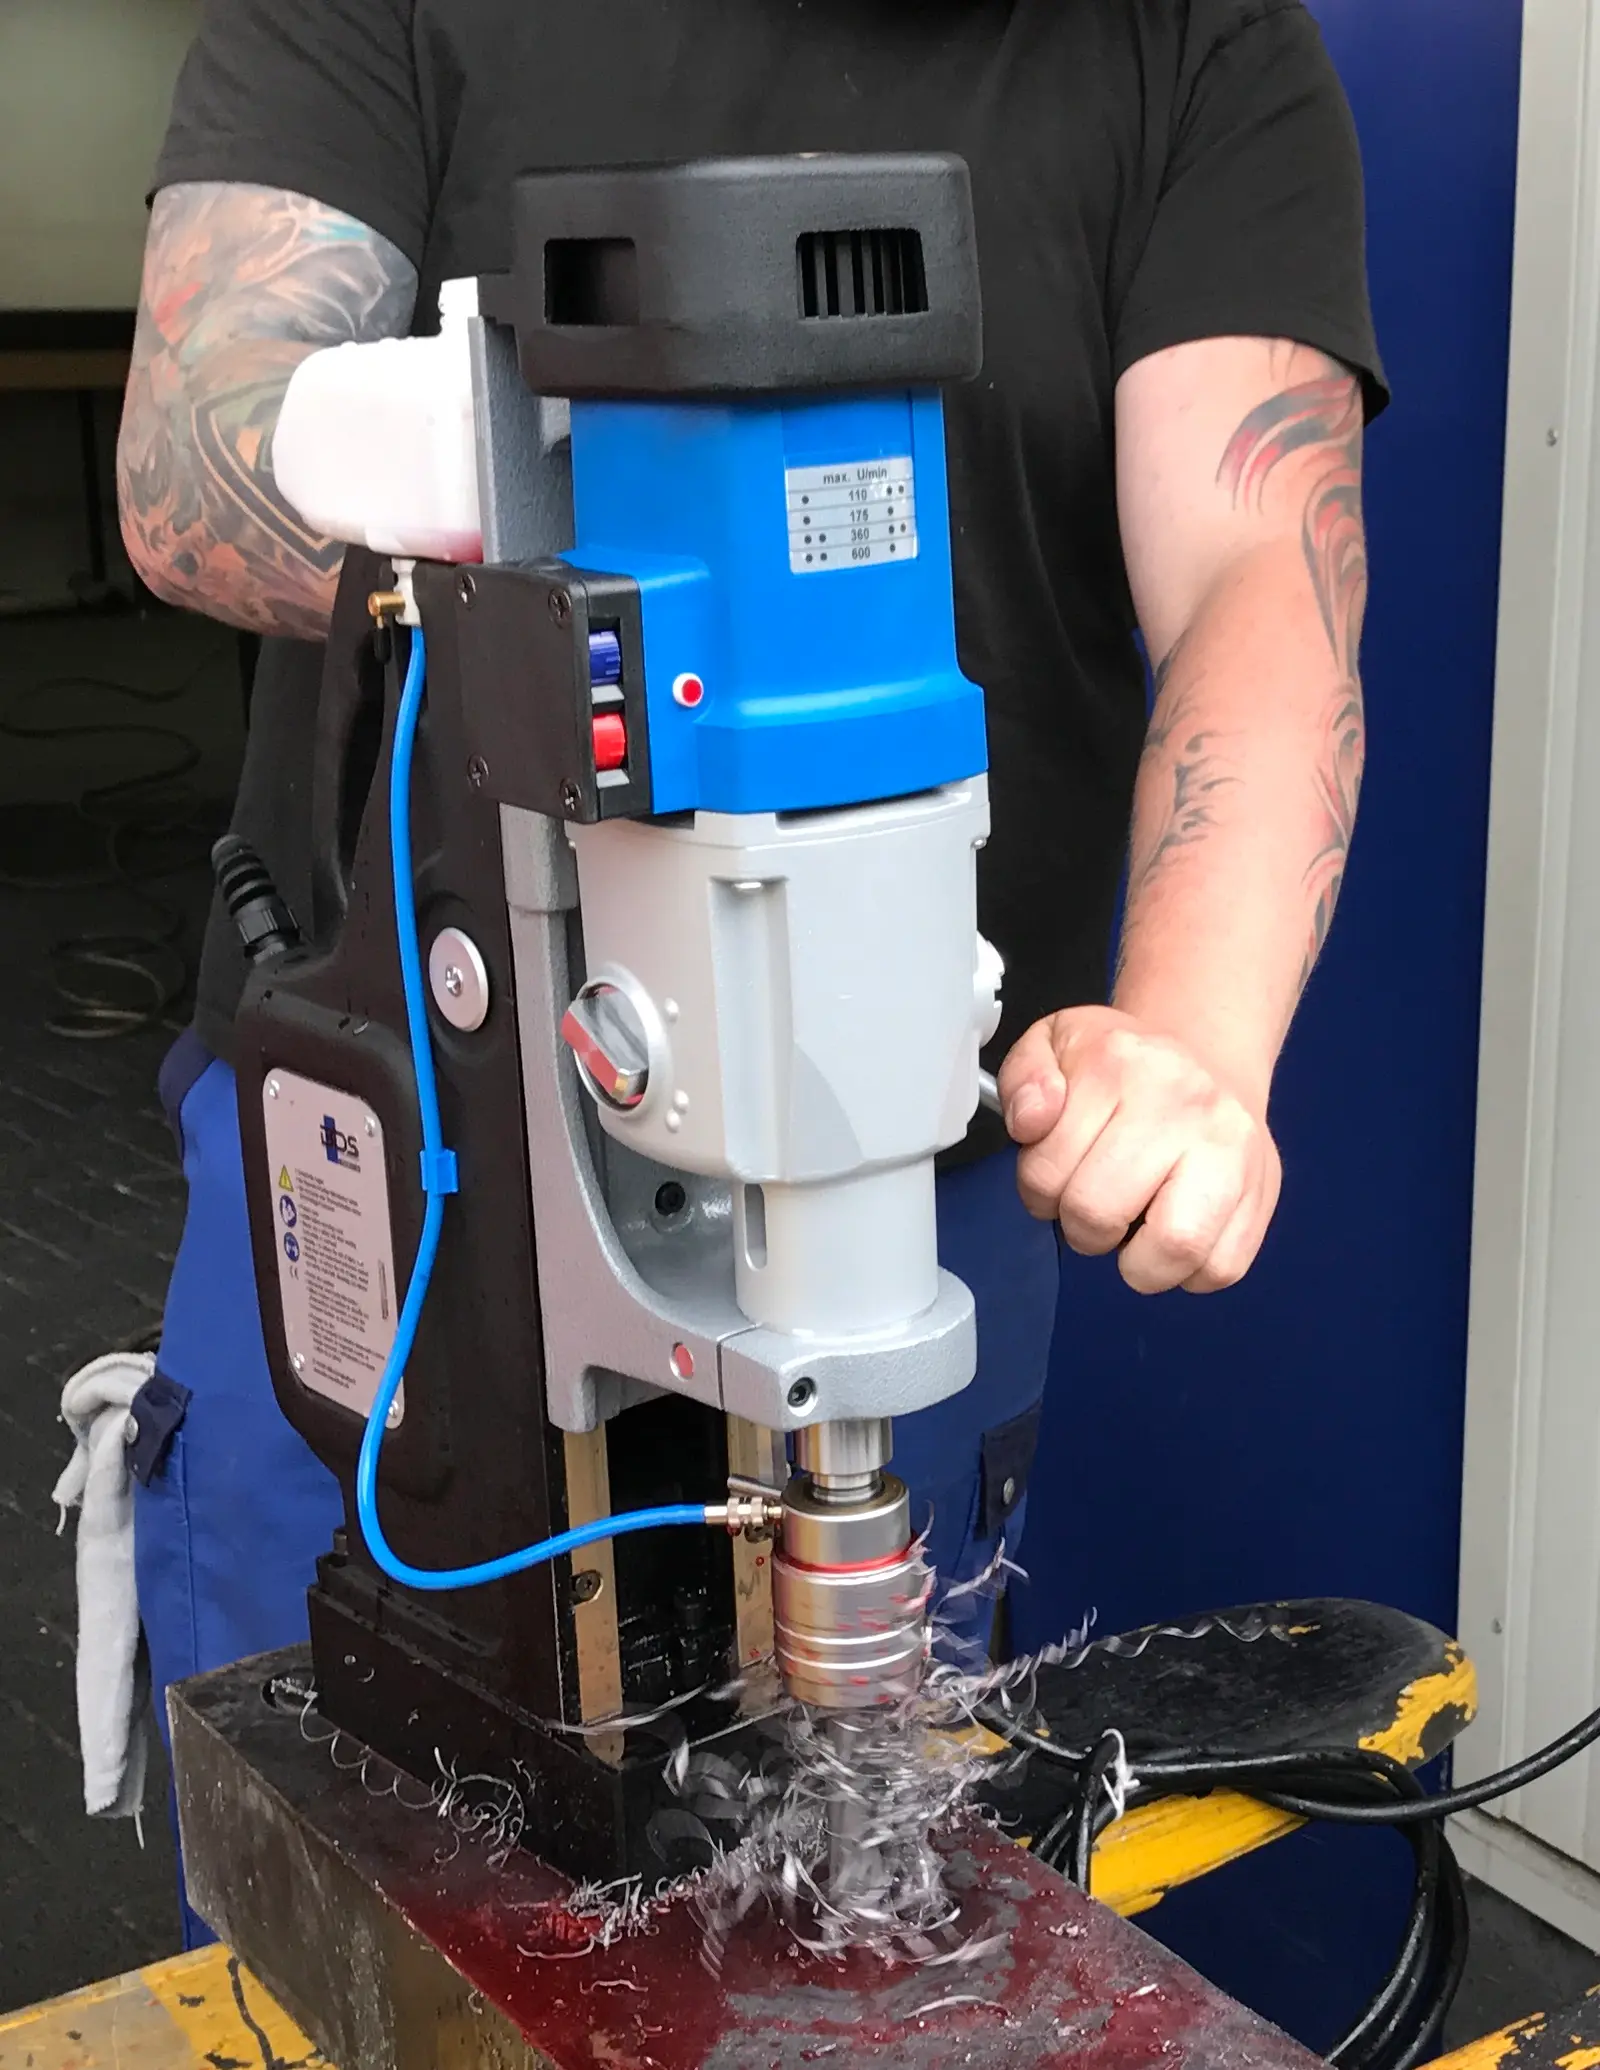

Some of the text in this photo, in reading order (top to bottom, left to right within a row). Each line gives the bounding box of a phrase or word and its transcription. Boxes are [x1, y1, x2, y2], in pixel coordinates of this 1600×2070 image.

[823, 467, 888, 484] max. U/min
[848, 489, 868, 501] 110
[849, 508, 869, 522] 175
[850, 527, 870, 541] 360
[851, 546, 871, 560] 600
